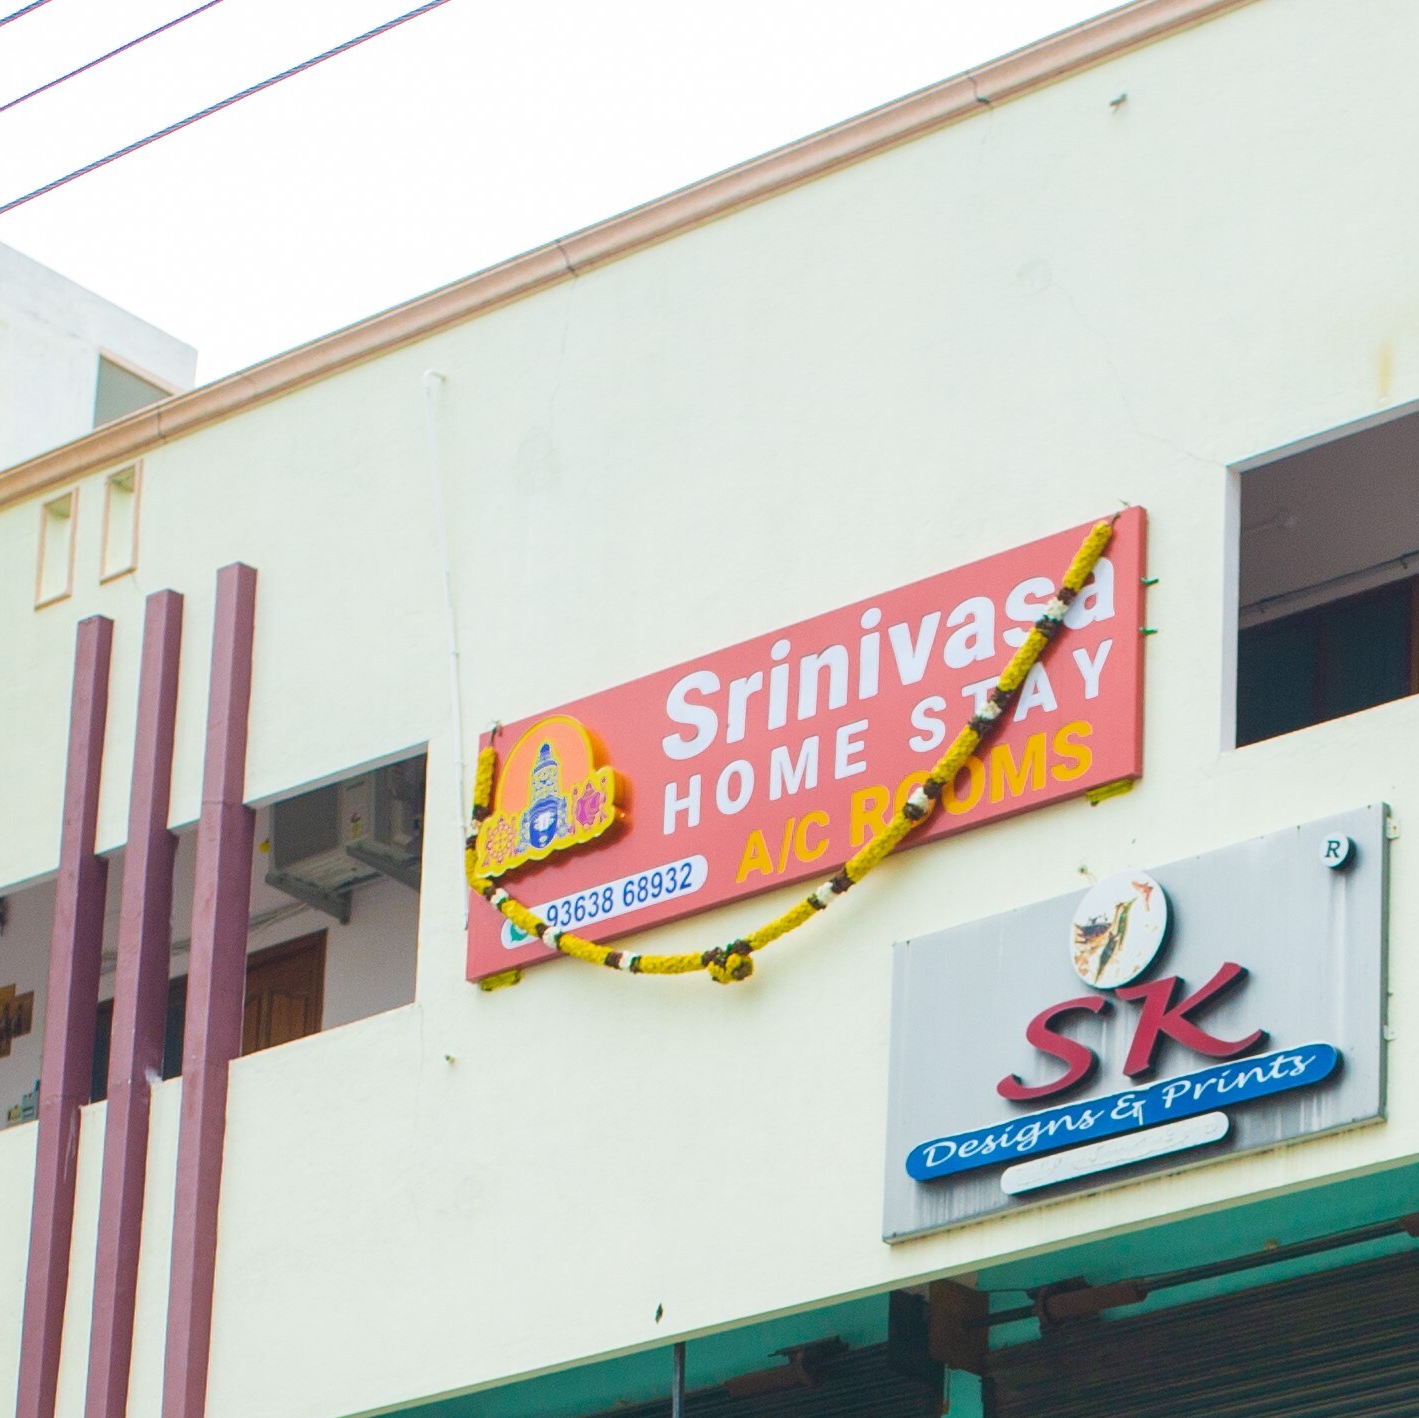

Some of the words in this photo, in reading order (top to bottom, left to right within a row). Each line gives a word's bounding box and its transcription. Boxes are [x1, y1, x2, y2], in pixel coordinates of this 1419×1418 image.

[661, 555, 1117, 763] Srinivasa
[662, 718, 869, 836] HOME
[545, 886, 615, 931] 93638
[622, 860, 693, 908] 68932
[734, 811, 830, 887] A/C
[996, 961, 1270, 1103] SK
[922, 1108, 1104, 1169] Designs
[1162, 1052, 1317, 1111] Prints
